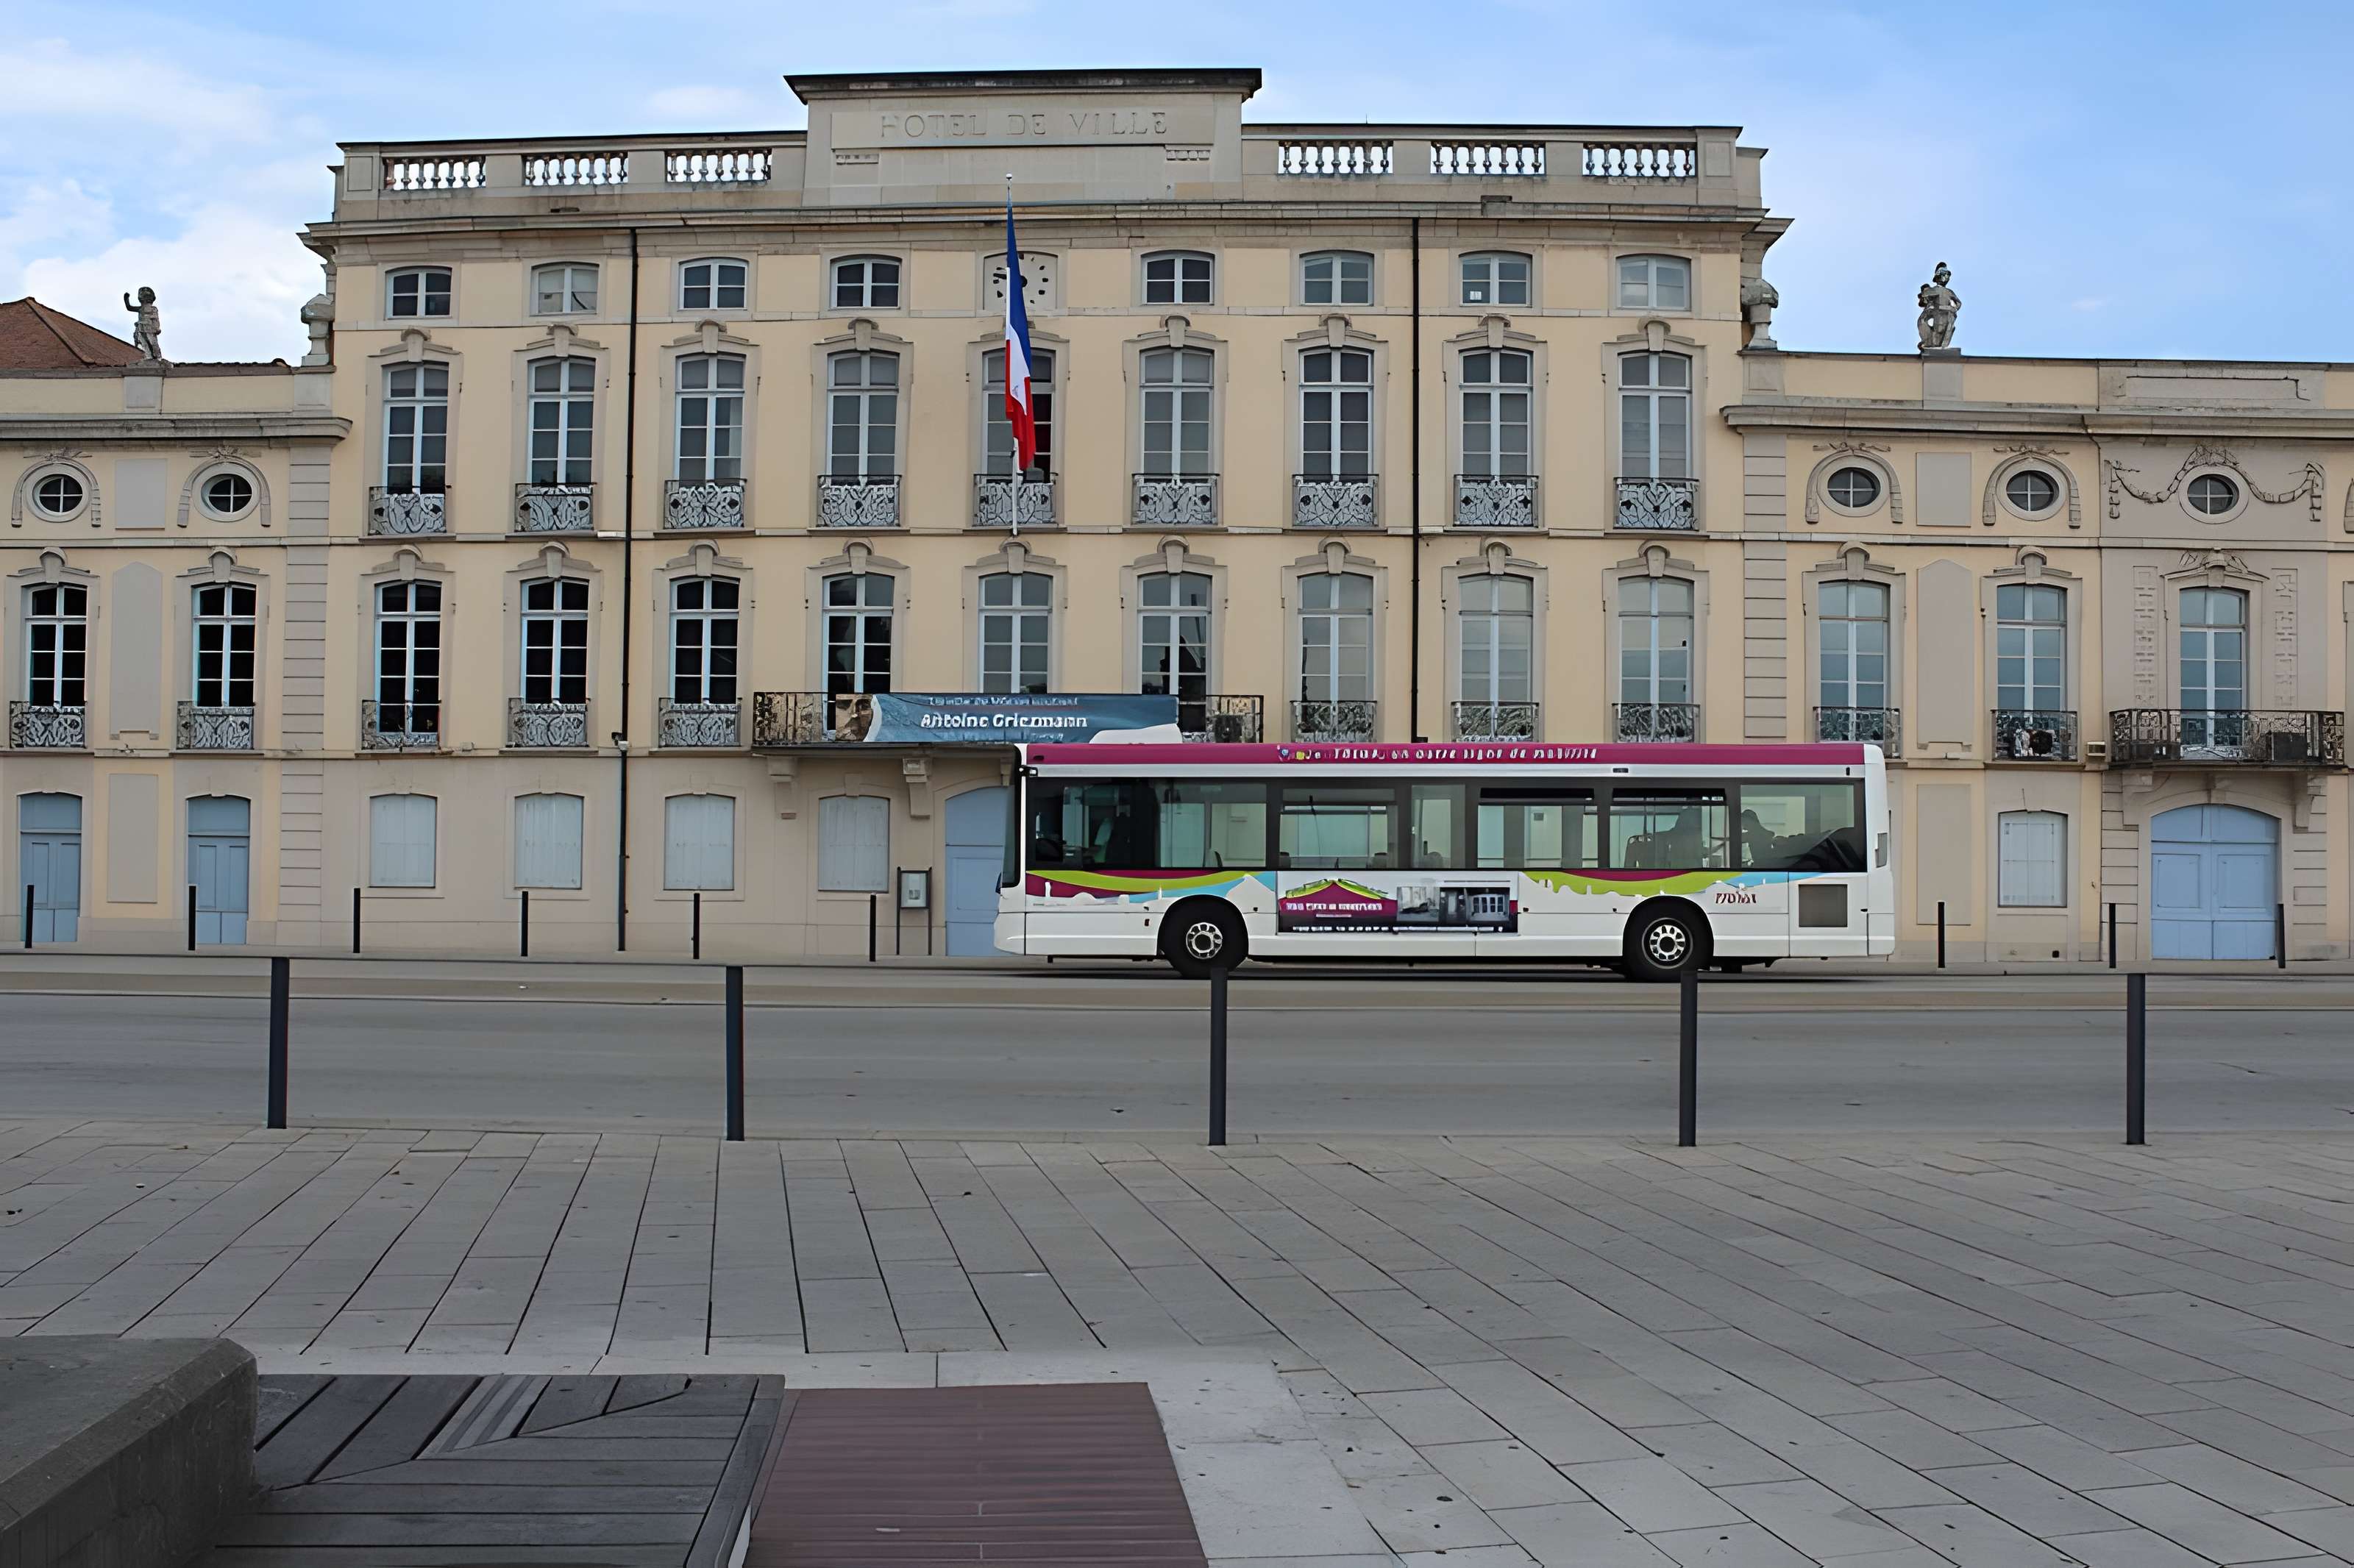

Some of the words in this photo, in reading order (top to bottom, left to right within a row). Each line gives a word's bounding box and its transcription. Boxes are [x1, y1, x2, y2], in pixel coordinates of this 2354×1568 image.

[881, 114, 986, 138] HOTEL
[1006, 113, 1046, 135] DE
[1068, 111, 1167, 135] VILLE
[920, 712, 989, 728] Antoine
